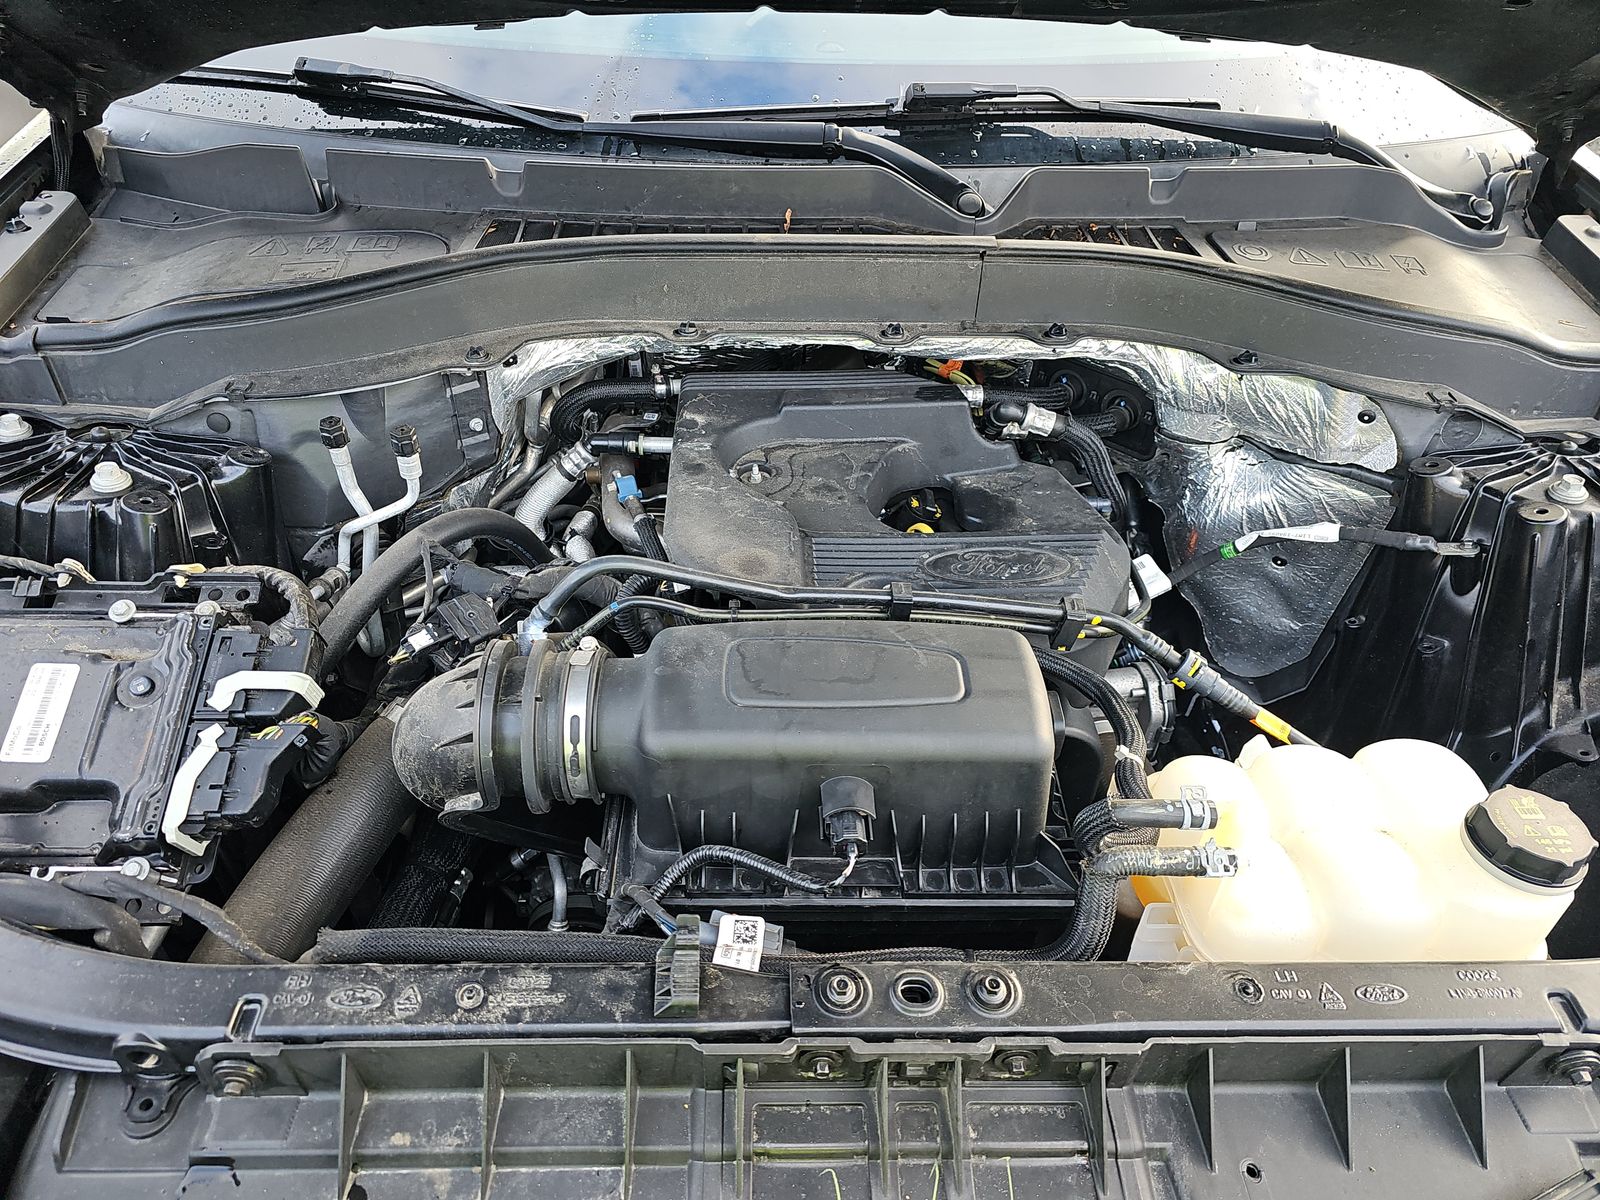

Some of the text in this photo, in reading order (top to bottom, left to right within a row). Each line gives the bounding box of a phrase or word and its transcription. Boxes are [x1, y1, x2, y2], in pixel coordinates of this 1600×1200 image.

[951, 551, 1047, 576] Ford
[39, 723, 51, 747] BOSCH
[1274, 970, 1298, 982] LH
